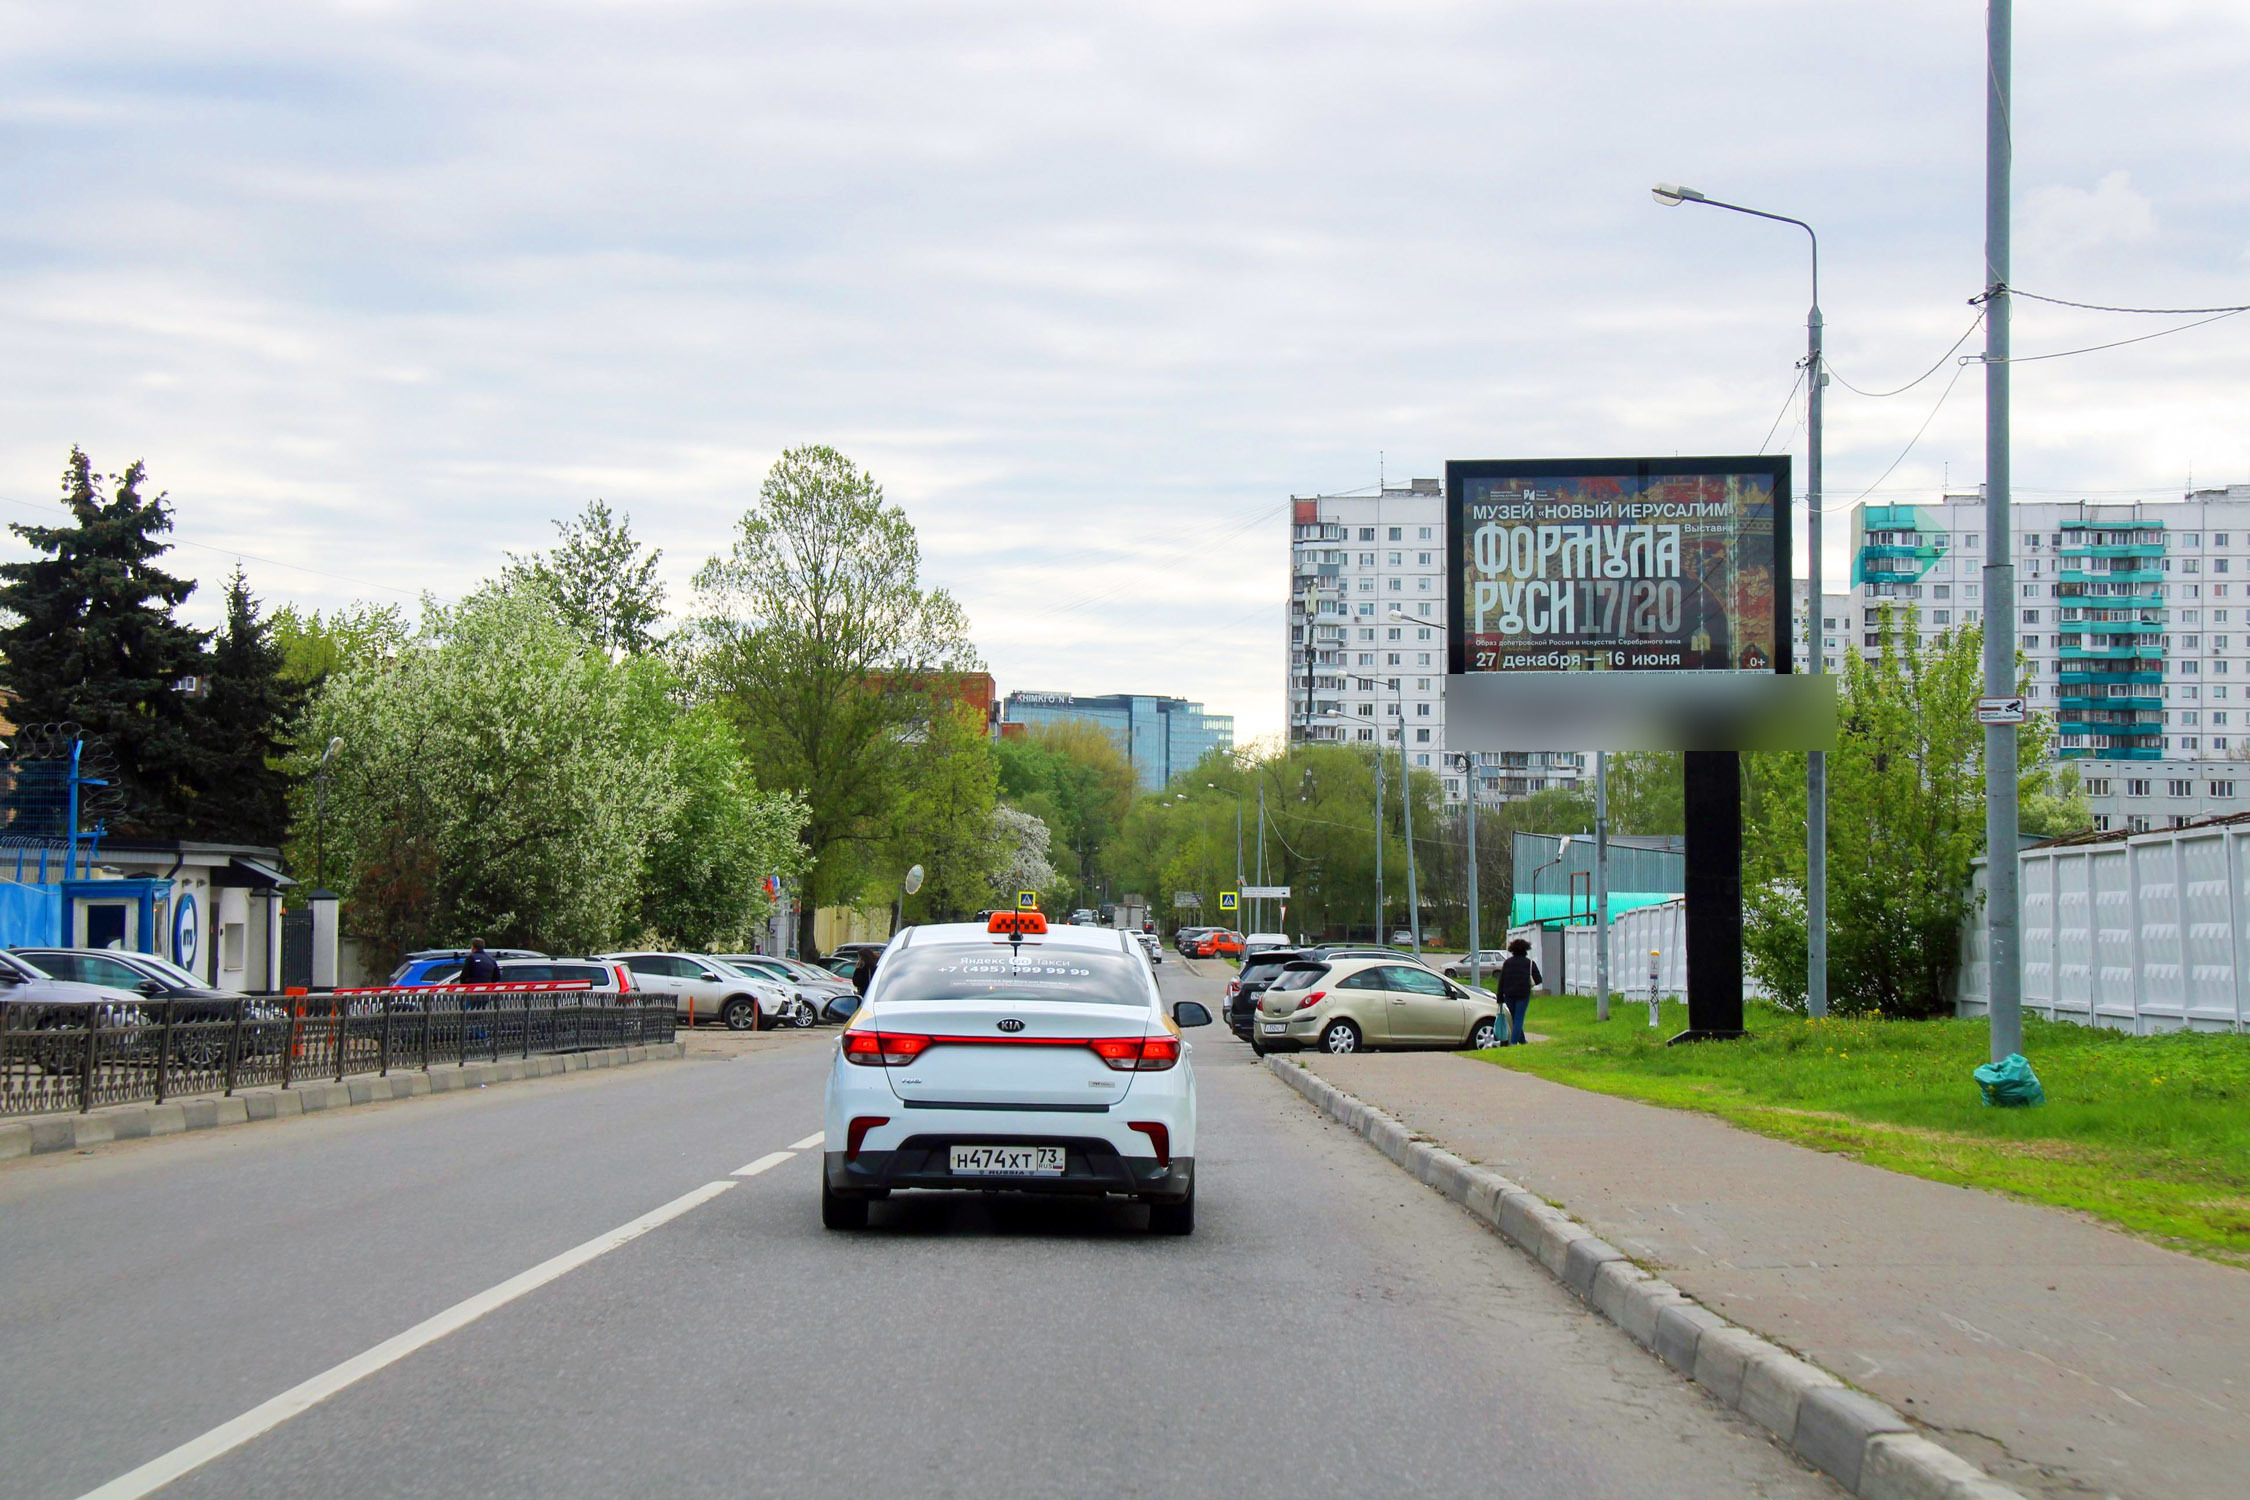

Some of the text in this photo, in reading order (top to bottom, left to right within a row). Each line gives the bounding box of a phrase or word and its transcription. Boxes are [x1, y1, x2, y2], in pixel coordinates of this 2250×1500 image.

[1473, 502, 1534, 520] МУЗЕЙ
[1538, 501, 1612, 519] «НОВЫЙ
[1474, 521, 1681, 579] ФОРМУЛА
[1474, 579, 1682, 638] РУСИ 17/20
[1475, 639, 1497, 647] Образ
[1618, 638, 1663, 647] Серебряного
[1476, 652, 1497, 667] 27
[1502, 651, 1581, 669] декабря
[1606, 651, 1625, 666] 16
[1632, 653, 1681, 666] июня
[1749, 657, 1766, 667] 0+
[1016, 694, 1047, 703] KHIMKI
[960, 957, 1005, 966] Яндекс
[1036, 958, 1070, 967] Такси
[963, 965, 1006, 974] (495)
[1011, 966, 1042, 974] 999
[1046, 967, 1066, 975] 99
[1070, 968, 1090, 976] 99
[1000, 1021, 1021, 1030] KIA
[957, 1148, 1057, 1169] Н474ХТ 73
